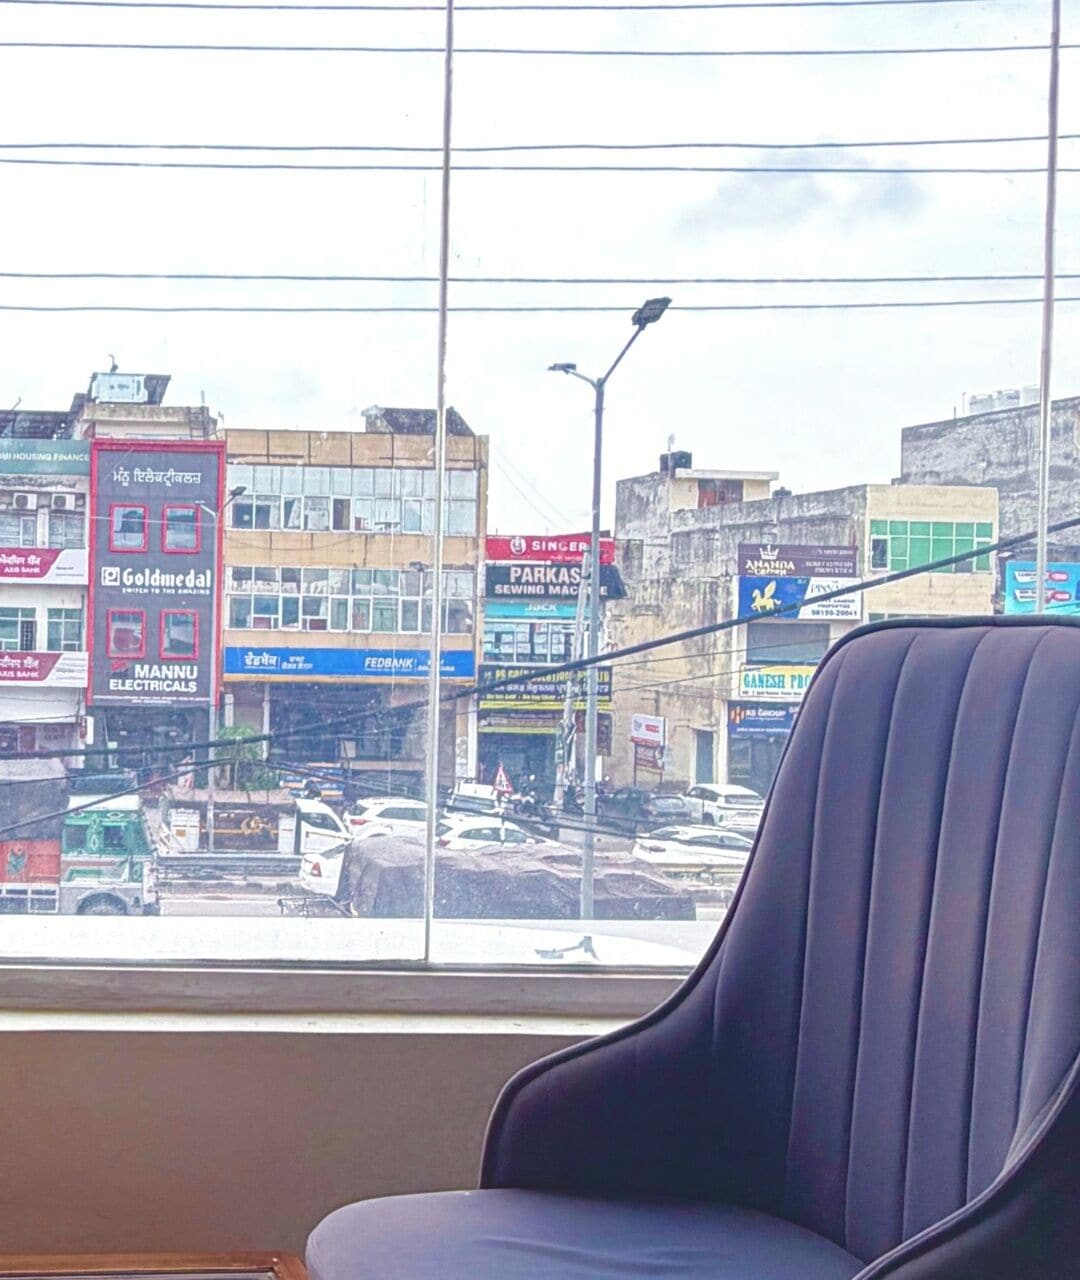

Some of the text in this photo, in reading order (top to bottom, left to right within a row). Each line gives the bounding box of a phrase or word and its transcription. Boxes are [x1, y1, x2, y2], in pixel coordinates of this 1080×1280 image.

[13, 453, 52, 461] HOUSING
[53, 453, 89, 462] FINANCE
[531, 540, 588, 552] SINGER
[122, 568, 211, 588] Goldmedal
[510, 567, 591, 584] PARKAS
[495, 584, 608, 596] SEWING MACE
[364, 657, 413, 668] FEDBANK
[134, 664, 198, 680] MANNU
[109, 679, 197, 693] ELECTRICALS
[743, 673, 785, 689] GANESH
